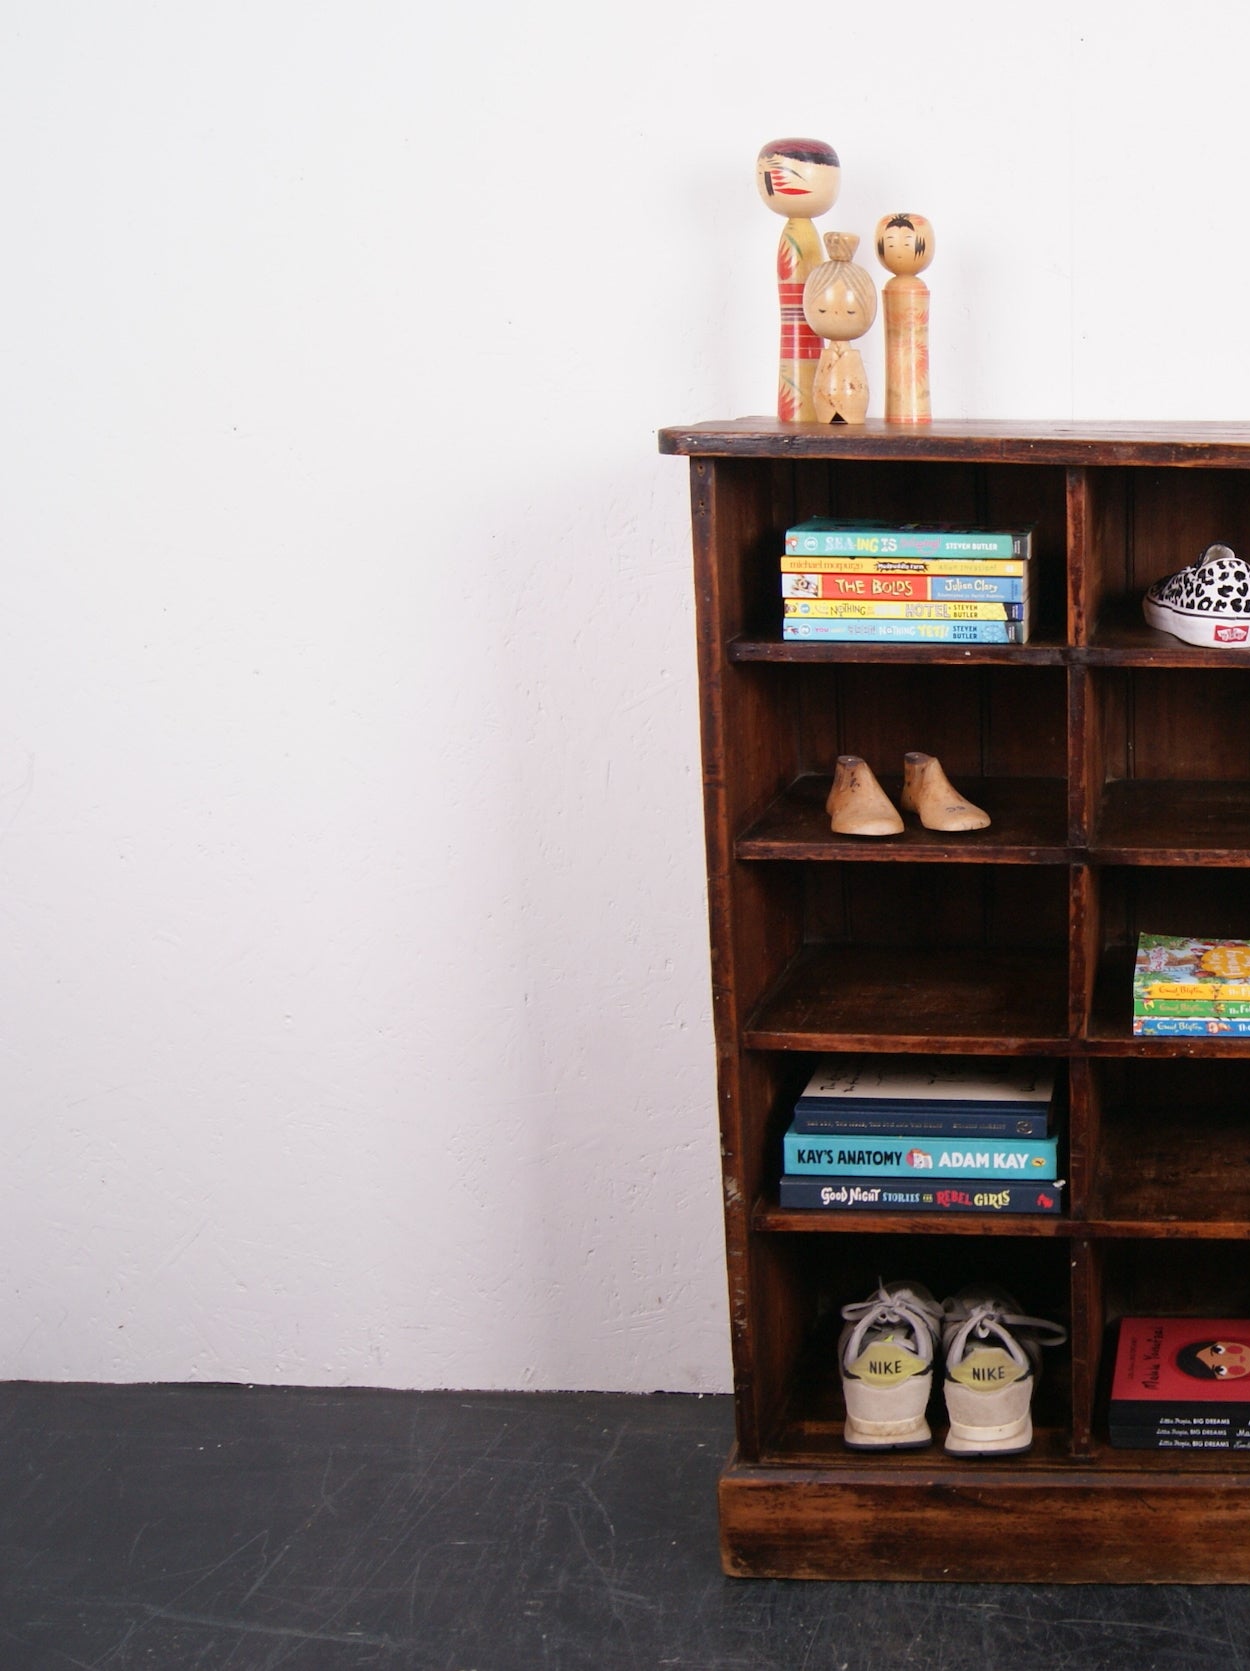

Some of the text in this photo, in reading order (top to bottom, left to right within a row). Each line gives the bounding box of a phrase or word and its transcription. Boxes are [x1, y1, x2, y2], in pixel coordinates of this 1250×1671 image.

[881, 538, 897, 552] IS
[946, 542, 971, 550] STEVEN
[972, 543, 998, 551] BUTLER
[790, 560, 864, 571] michael morpurgo
[835, 578, 913, 596] THE BOLDS
[944, 579, 972, 592] Julian
[974, 579, 998, 593] Clary
[830, 603, 866, 617] NOTHING
[905, 603, 951, 618] HOTEL
[879, 626, 916, 636] NOTHING
[1180, 984, 1204, 994] Blyton
[1179, 1020, 1204, 1031] Blyton
[797, 1149, 902, 1166] KAY'S ANATOMY
[938, 1152, 1029, 1169] ADAM KAY
[882, 1192, 920, 1203] STORIES
[935, 1190, 973, 1208] REBEL
[973, 1189, 1010, 1209] GIRLS
[869, 1360, 902, 1375] NIKE
[972, 1366, 1005, 1382] NIKE
